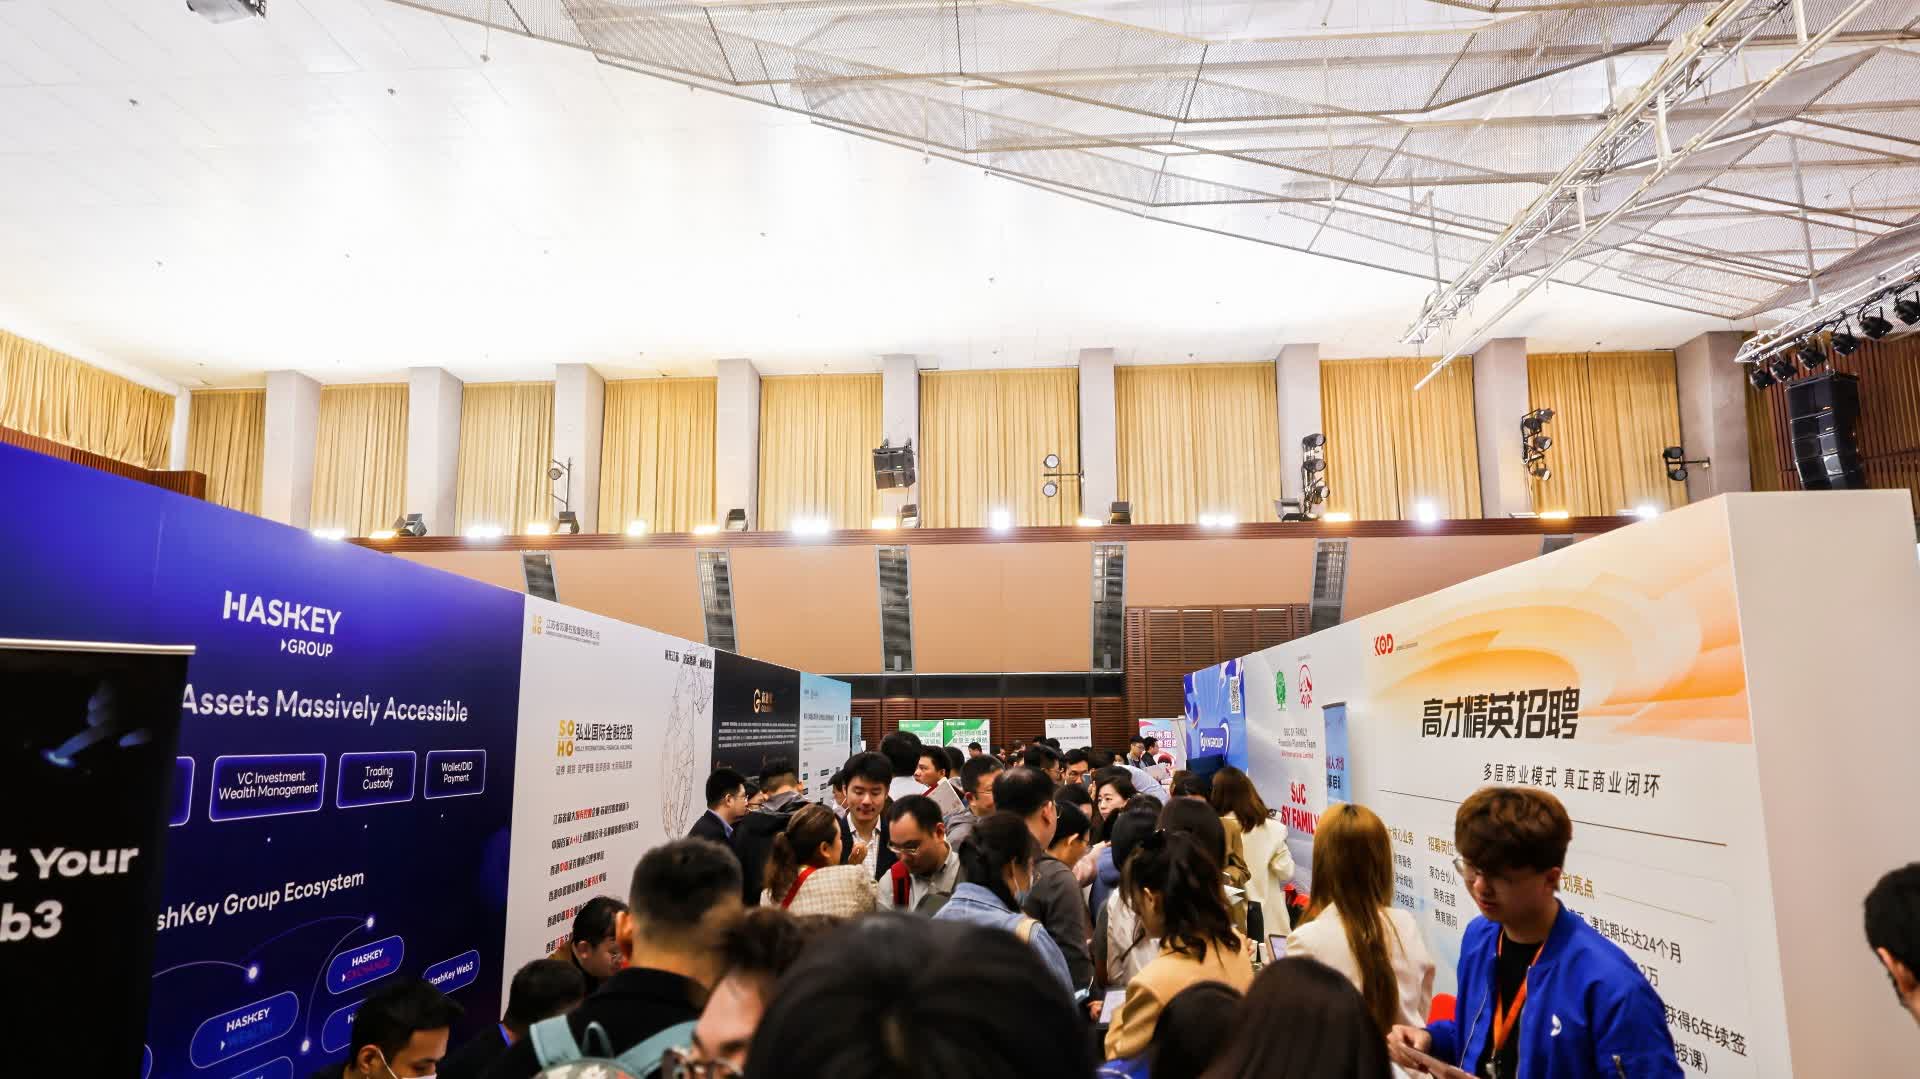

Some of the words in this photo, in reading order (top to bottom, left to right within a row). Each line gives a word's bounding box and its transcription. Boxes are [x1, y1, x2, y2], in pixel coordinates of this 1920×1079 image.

[223, 590, 342, 635] HASHKEY
[287, 638, 333, 657] GROUP
[182, 683, 269, 717] Assets
[275, 689, 380, 726] Massively
[383, 697, 468, 722] Accessible
[1422, 686, 1581, 739] 高才精英招聘
[559, 719, 575, 737] SO
[576, 723, 633, 741] 弘业国际金融控股
[557, 740, 573, 757] HO
[365, 766, 394, 778] Trading
[441, 761, 473, 772] Wallet/DID
[237, 772, 254, 785] VC
[255, 770, 306, 784] Investment
[362, 778, 394, 791] Custody
[443, 773, 470, 784] Payment
[1483, 763, 1557, 788] 多层商业模式
[1564, 768, 1662, 798] 真正商业闭环
[218, 786, 256, 800] Wealth
[257, 783, 319, 798] Management
[29, 847, 139, 879] Your
[224, 892, 281, 915] Group
[284, 872, 365, 903] Ecosystem
[351, 948, 384, 967] HASHKEY
[456, 961, 474, 975] Web3
[226, 1007, 271, 1033] HASHKEY
